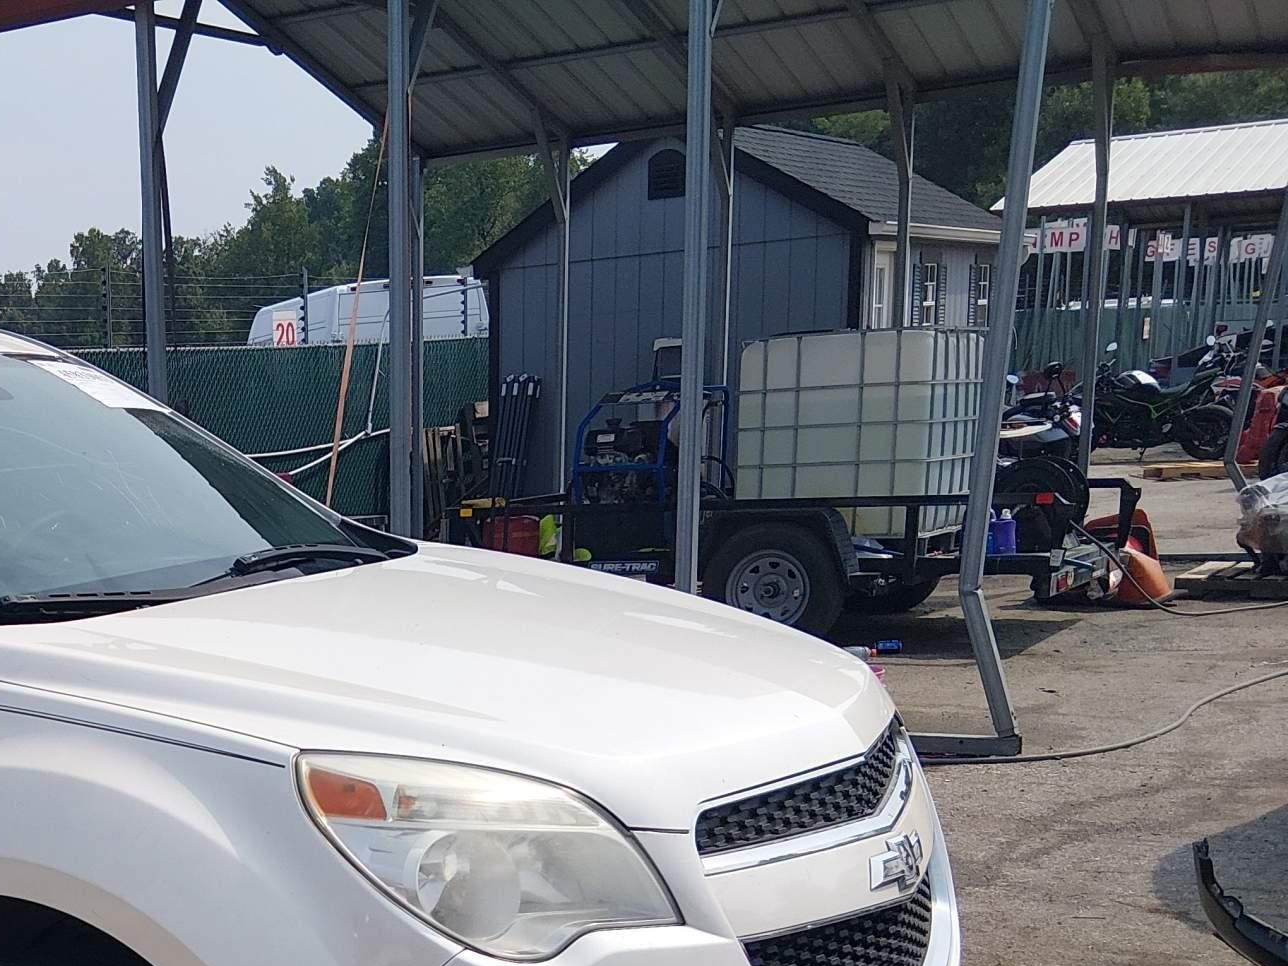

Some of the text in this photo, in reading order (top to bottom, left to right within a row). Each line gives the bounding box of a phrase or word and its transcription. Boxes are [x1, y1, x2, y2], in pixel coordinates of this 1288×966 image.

[1050, 231, 1064, 247] M
[1068, 231, 1080, 248] P
[1109, 230, 1120, 245] H
[1207, 240, 1216, 253] S
[1244, 242, 1256, 255] G
[275, 321, 295, 346] 20
[590, 562, 657, 573] SURE-TRAC
